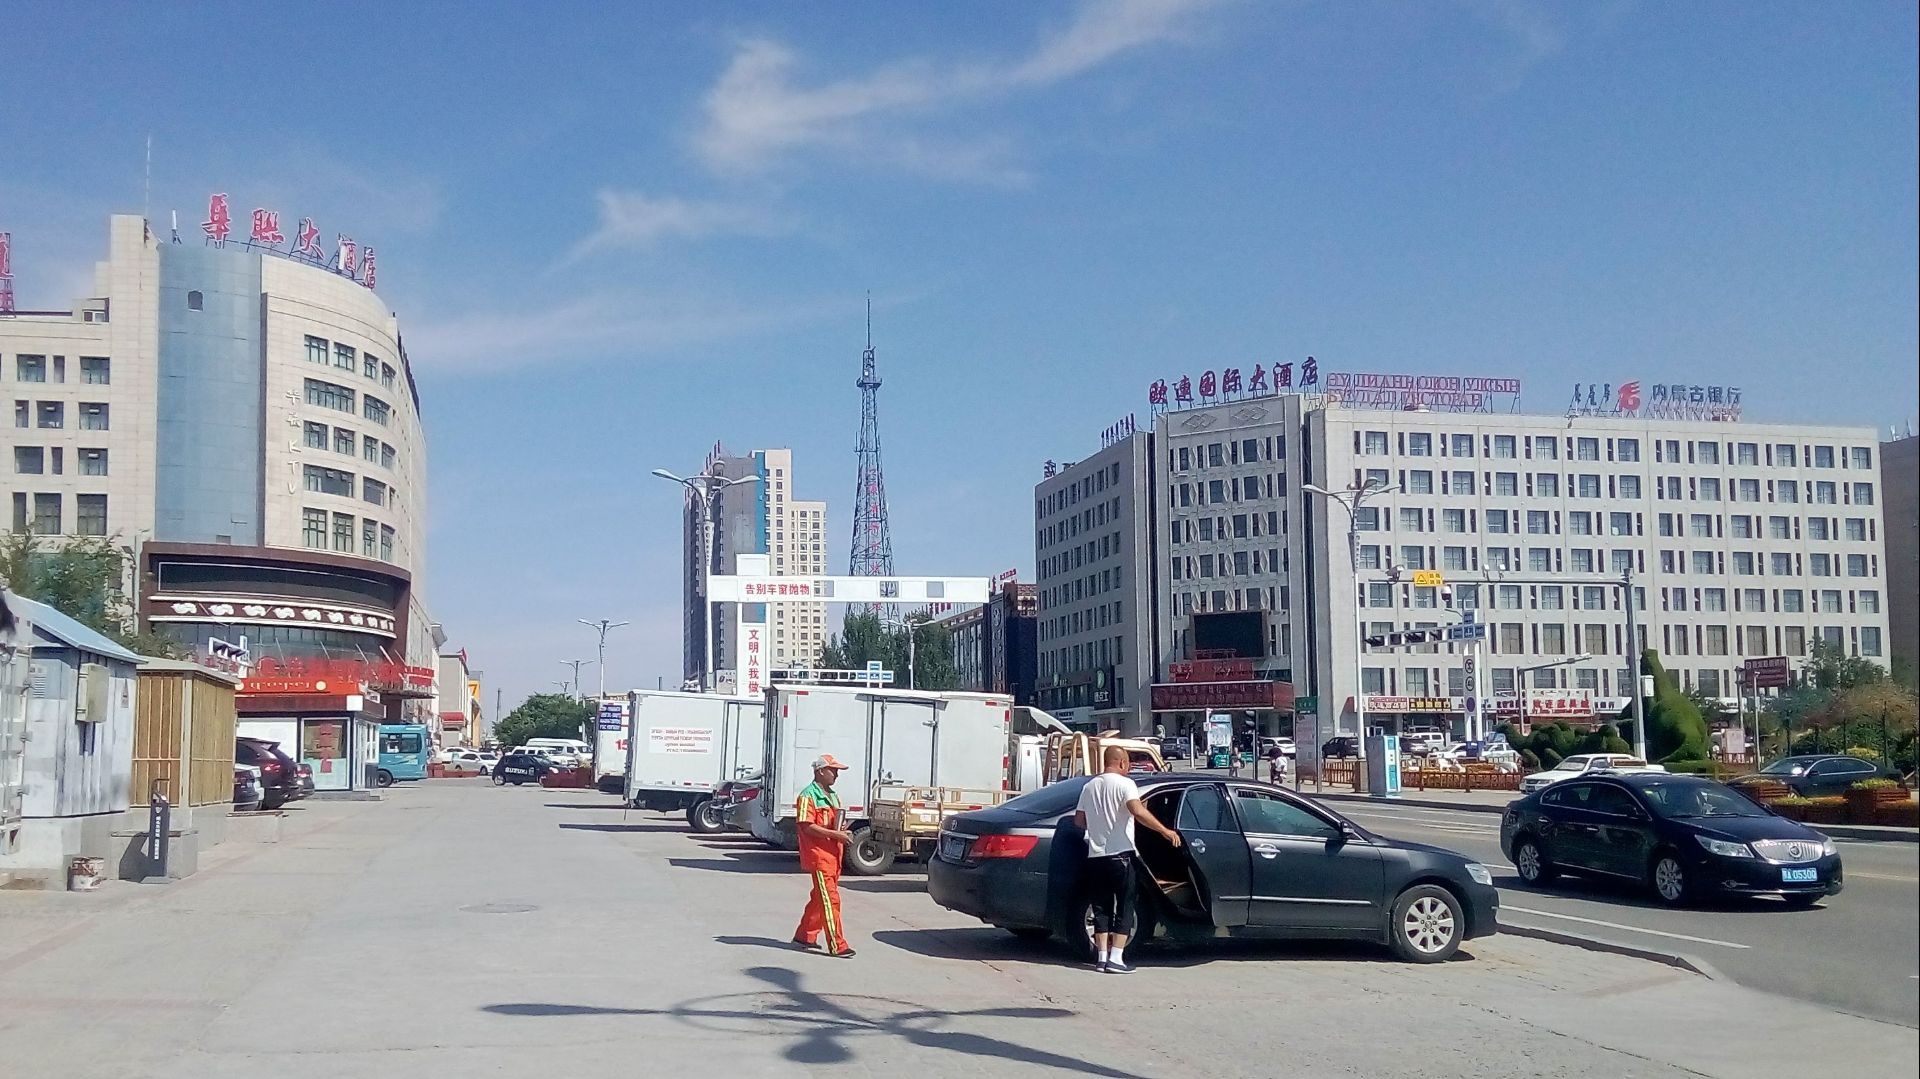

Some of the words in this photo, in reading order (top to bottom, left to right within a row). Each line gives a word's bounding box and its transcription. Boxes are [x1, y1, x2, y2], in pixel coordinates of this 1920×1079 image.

[745, 584, 810, 595] 告别车窗抛物
